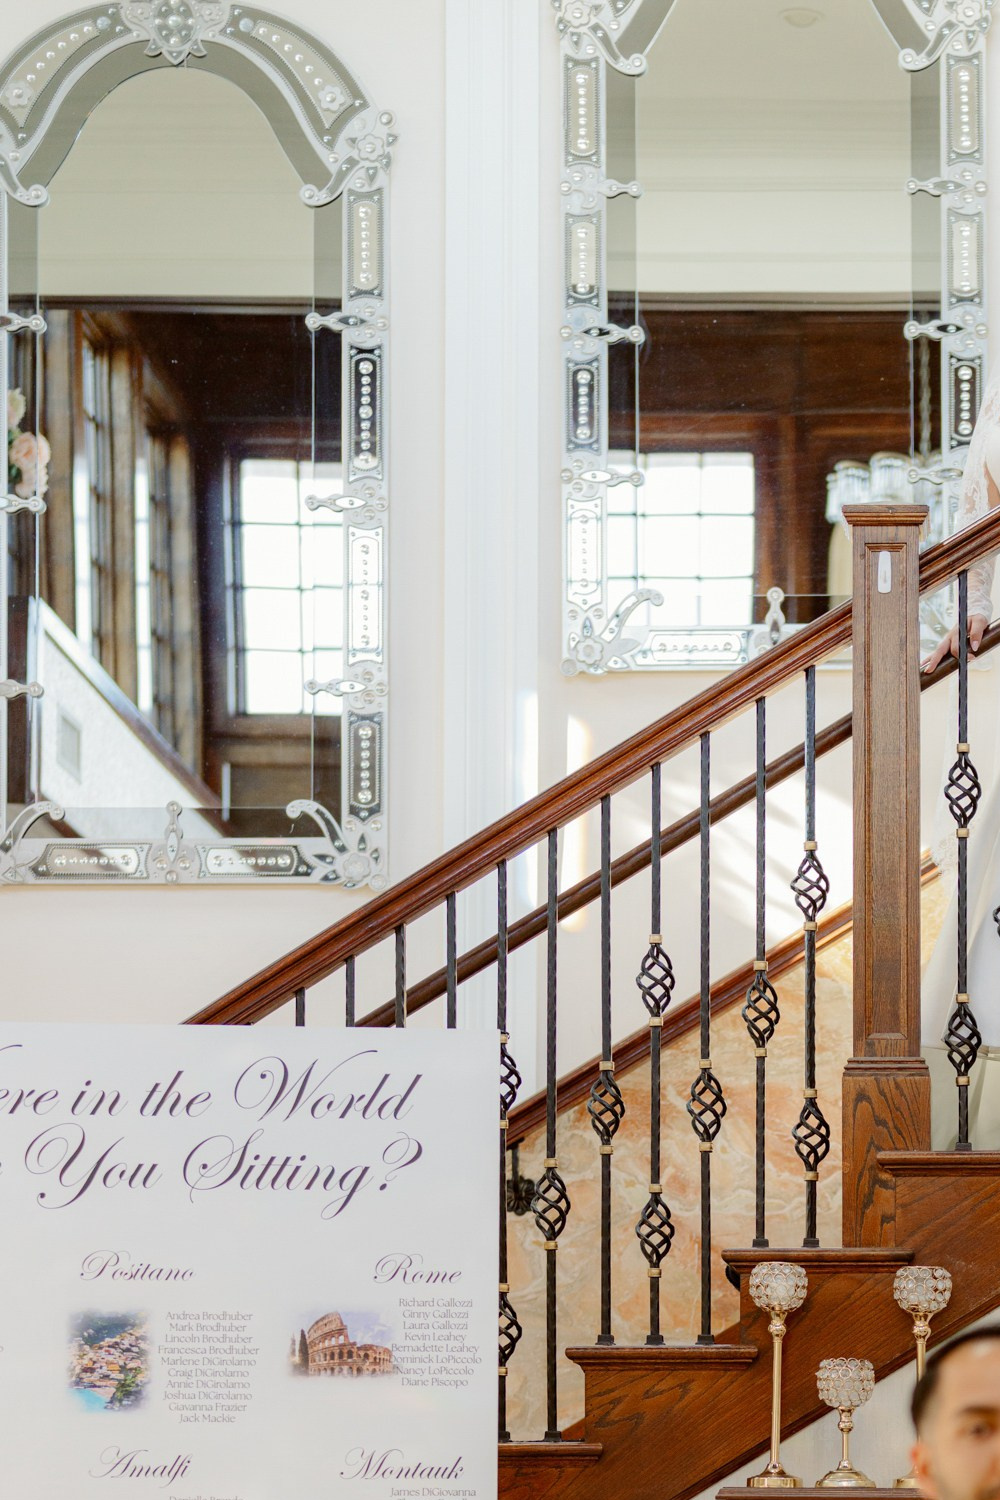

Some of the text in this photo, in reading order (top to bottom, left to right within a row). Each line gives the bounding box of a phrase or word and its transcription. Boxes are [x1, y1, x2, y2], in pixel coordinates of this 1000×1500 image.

[71, 1080, 128, 1117] in
[139, 1070, 212, 1118] the
[234, 1050, 423, 1122] World
[24, 1122, 423, 1219] You Sitting?
[80, 1250, 196, 1281] Positano
[373, 1252, 463, 1284] Rome
[399, 1298, 473, 1307] Richard Gallozzi
[167, 1311, 253, 1320] Andrea Brodhuber
[403, 1310, 468, 1320] Ginny Gallozzi
[170, 1323, 247, 1331] Mark Brodhuber
[403, 1321, 468, 1329] Laura Gallozzi
[165, 1334, 253, 1343] Lincoln Brodhuber
[404, 1332, 466, 1343] Kevin Leahey
[158, 1345, 260, 1354] Francesca Brodhuber
[392, 1343, 479, 1354] Bernadette Leahey
[162, 1357, 256, 1365] Marlene DiGirolamo
[168, 1368, 249, 1379] Craig DiGirolamo
[394, 1366, 474, 1376] Nancy LoPiccolo
[166, 1380, 250, 1388] Annie DiGirolamo
[401, 1378, 468, 1389] Diane Piscopo
[163, 1391, 252, 1400] Joshua DiGirolamo
[216, 1403, 247, 1411] Frazier
[179, 1414, 236, 1423] Jack Mackie
[89, 1446, 193, 1489] Amalfi
[339, 1447, 464, 1480] Montauk
[390, 1488, 476, 1497] James DiGiovanna
